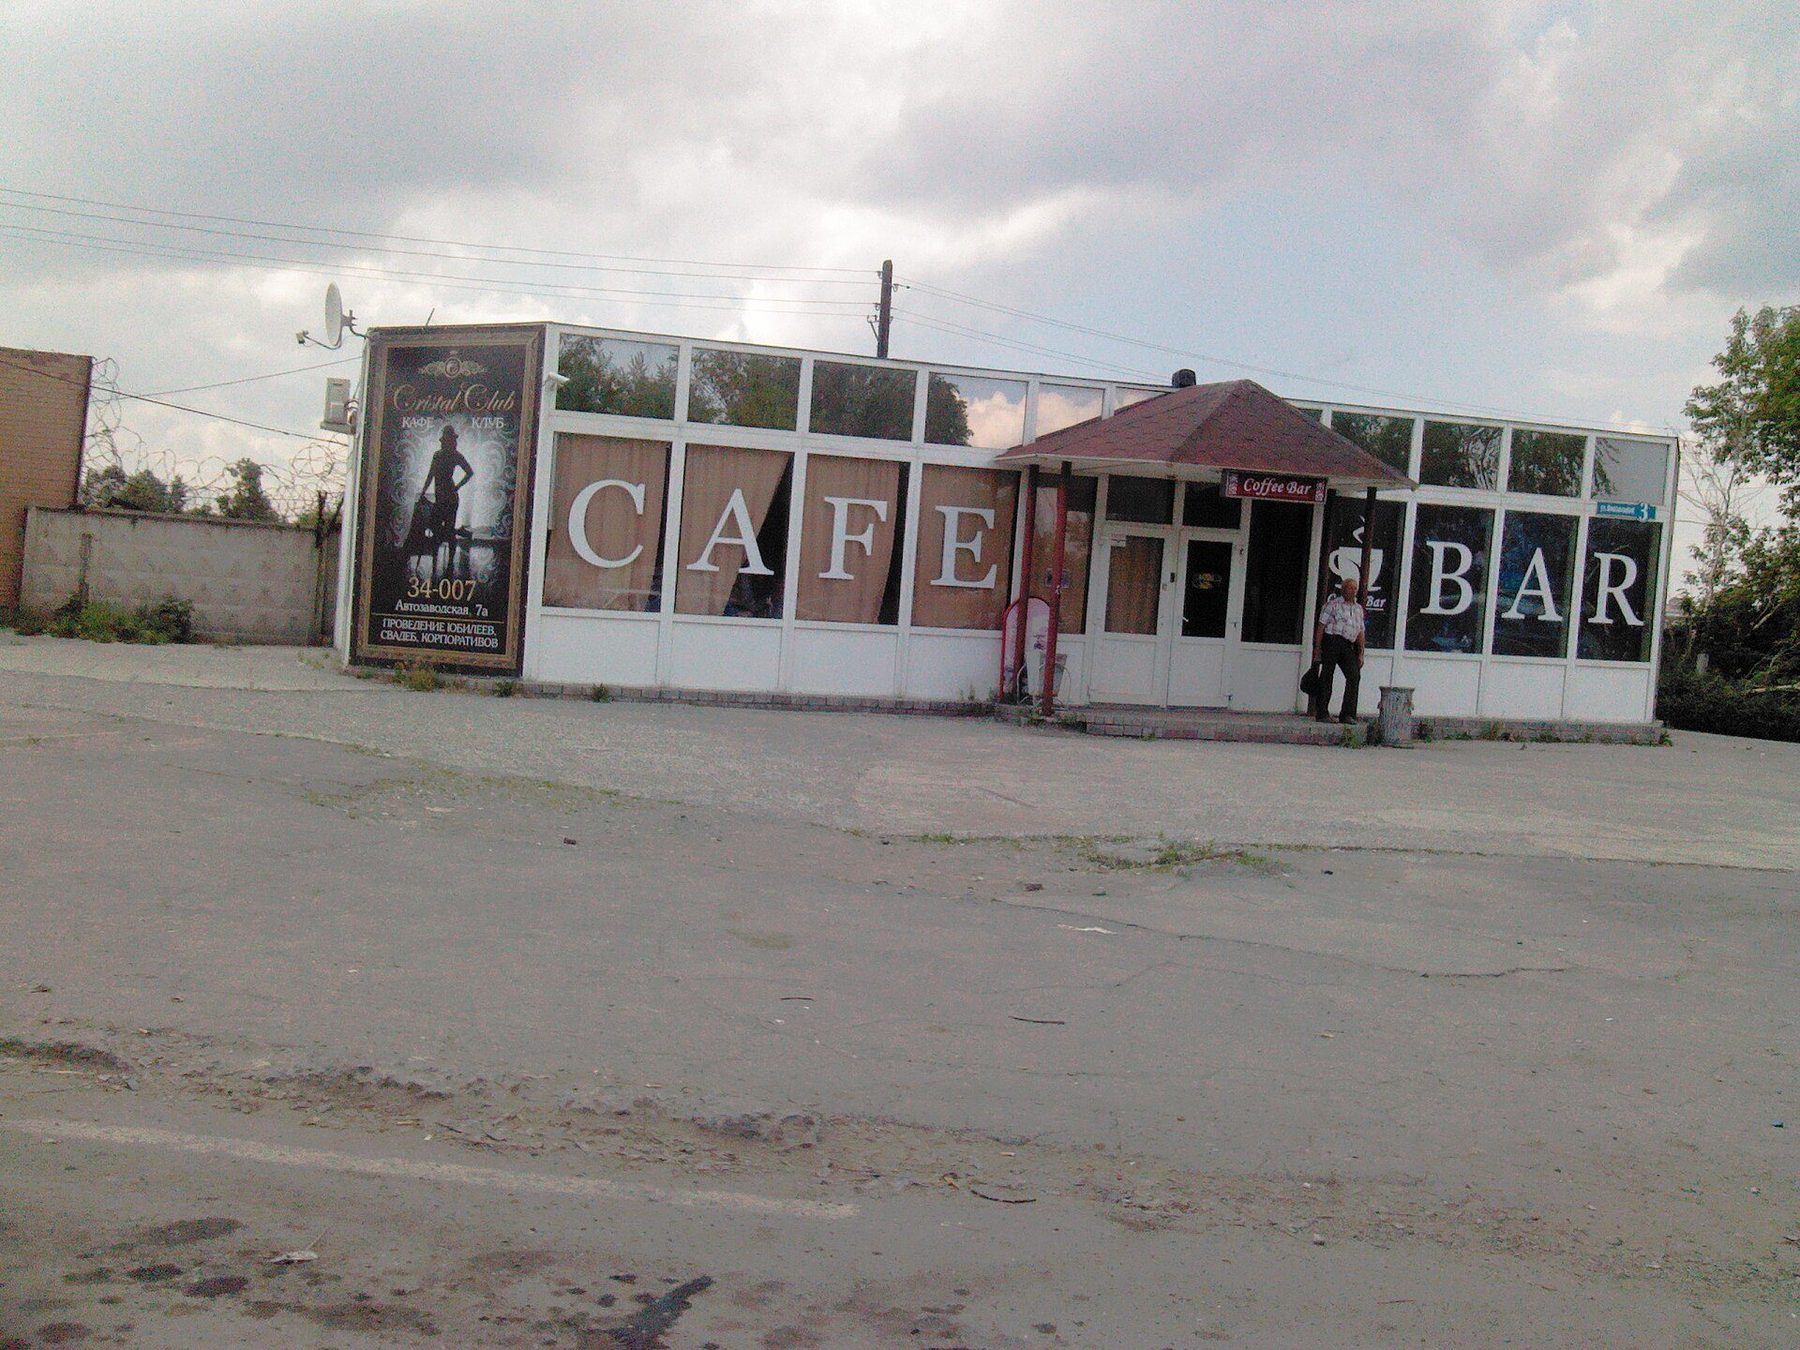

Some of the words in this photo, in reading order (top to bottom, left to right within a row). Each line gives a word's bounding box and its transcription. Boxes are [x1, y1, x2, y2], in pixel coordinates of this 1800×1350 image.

[461, 382, 516, 411] Club
[402, 416, 435, 429] КАФЕ
[472, 416, 505, 430] КЛУБ
[1243, 477, 1285, 497] Coffee
[1286, 481, 1312, 495] Bar
[1638, 502, 1649, 523] 3
[568, 479, 998, 589] CAFE
[407, 576, 477, 602] 34-007
[1420, 540, 1645, 626] BAR
[475, 604, 489, 617] 7а
[1365, 595, 1387, 608] Bar
[382, 618, 446, 632] ПРОВЕДЕНИЕ
[421, 632, 499, 648] КОРПОРАТИВОВ
